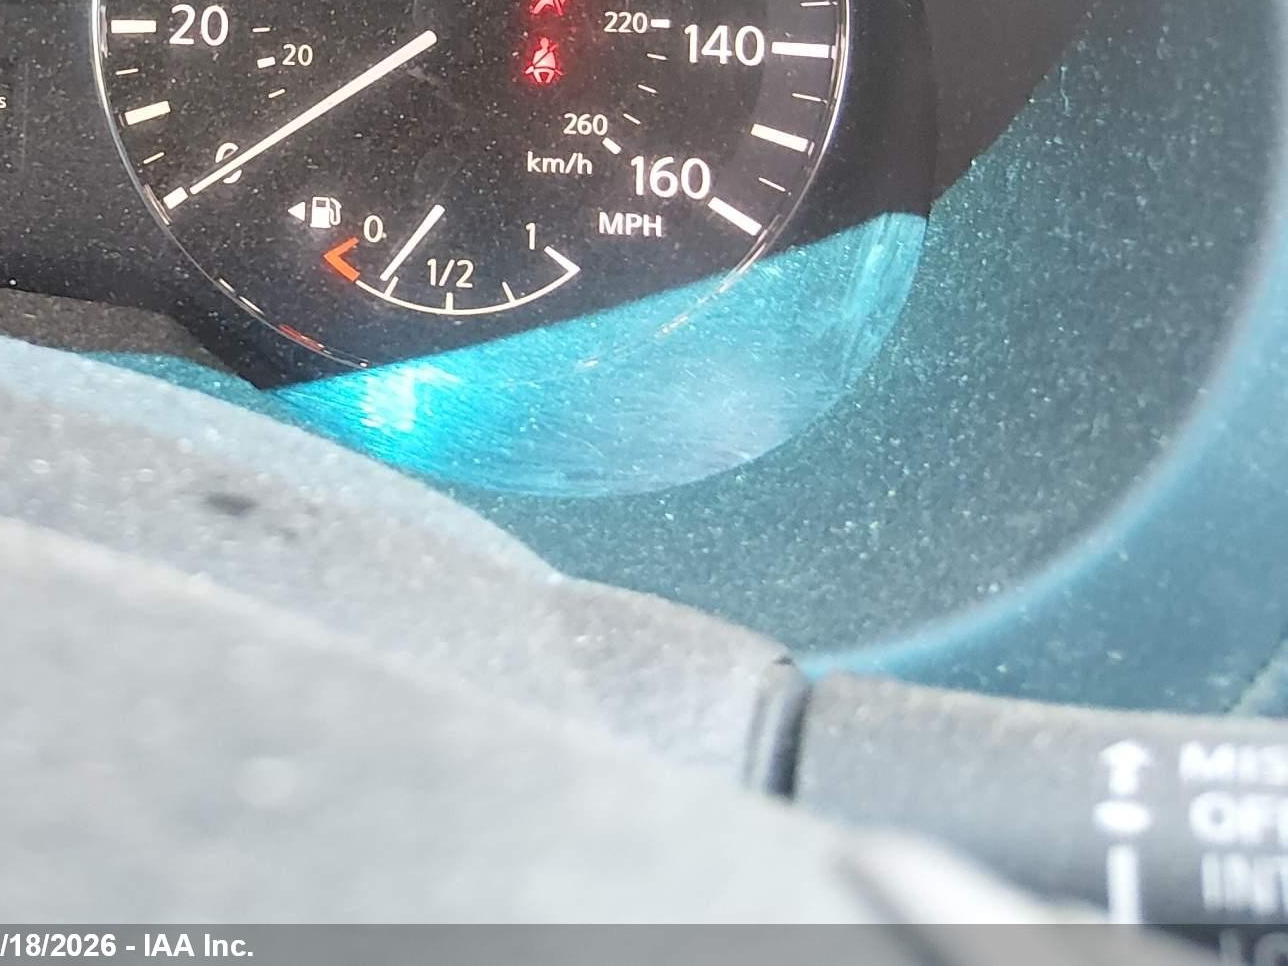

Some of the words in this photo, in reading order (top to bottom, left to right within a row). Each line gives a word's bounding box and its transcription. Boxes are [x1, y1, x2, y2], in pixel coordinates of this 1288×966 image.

[169, 4, 229, 46] 20
[603, 11, 648, 34] 220
[282, 43, 313, 67] 20
[684, 24, 765, 67] 140
[563, 112, 608, 136] 260
[527, 150, 593, 175] km/h
[630, 155, 711, 200] 160
[363, 214, 385, 243] 0
[525, 222, 536, 250] 1
[598, 212, 663, 238] MPH
[427, 258, 474, 288] 1/2
